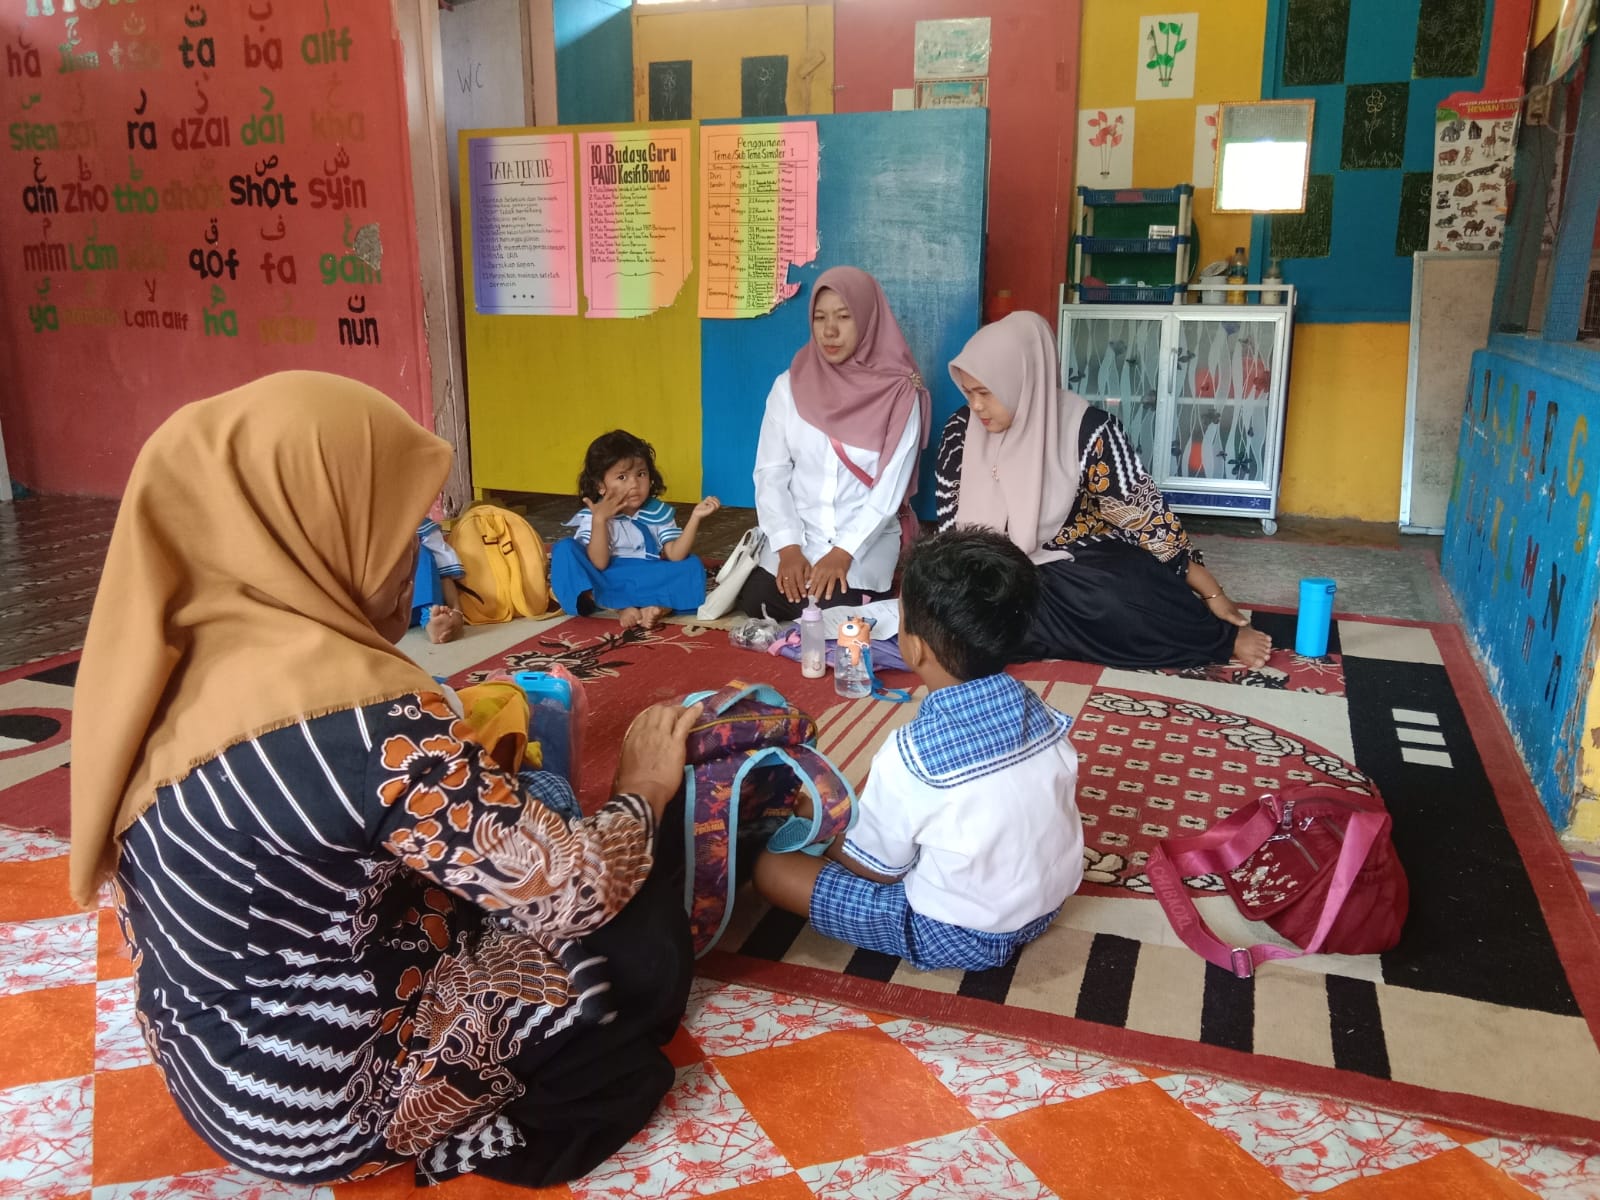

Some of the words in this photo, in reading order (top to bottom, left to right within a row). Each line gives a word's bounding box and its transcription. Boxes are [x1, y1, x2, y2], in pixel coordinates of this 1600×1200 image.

[6, 45, 41, 78] ha
[179, 36, 215, 68] ta
[244, 35, 283, 70] ba
[302, 27, 352, 64] alif
[457, 63, 483, 93] WC
[127, 120, 157, 149] ra
[172, 116, 230, 150] dzal
[241, 113, 285, 146] dal
[738, 136, 786, 151] Penggunaan
[591, 144, 602, 165] 10
[606, 143, 647, 165] Budaya
[648, 142, 677, 162] Guru
[486, 160, 514, 180] TATA
[513, 158, 554, 180] TERTIB
[591, 165, 617, 185] PAUD
[642, 163, 670, 183] Bunda
[22, 184, 58, 214] ain
[113, 183, 160, 214] tho
[23, 242, 67, 271] mim
[190, 248, 239, 280] qof
[260, 252, 297, 284] fa
[28, 304, 60, 333] ya
[162, 311, 188, 330] alif
[203, 307, 239, 336] ha
[338, 317, 379, 346] nun
